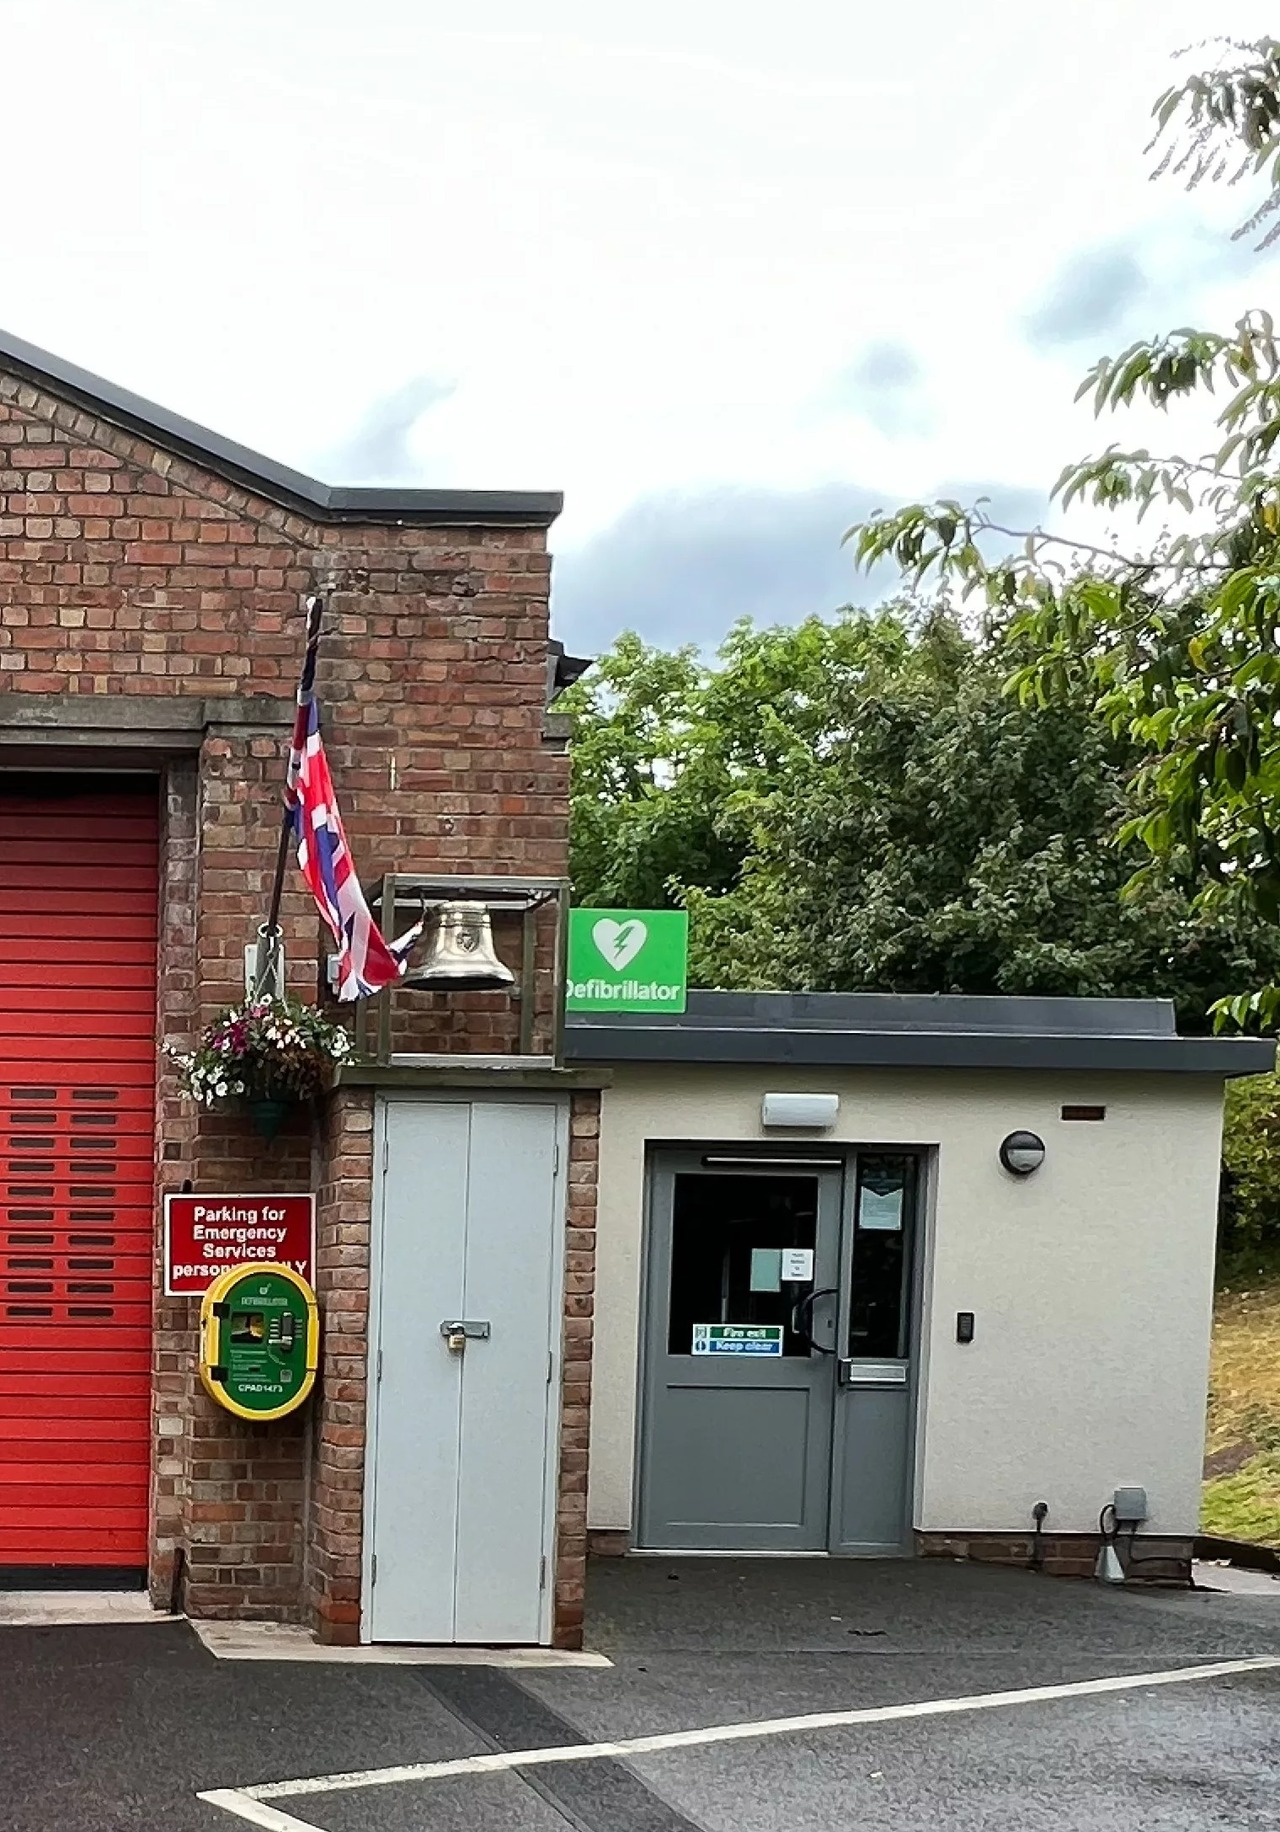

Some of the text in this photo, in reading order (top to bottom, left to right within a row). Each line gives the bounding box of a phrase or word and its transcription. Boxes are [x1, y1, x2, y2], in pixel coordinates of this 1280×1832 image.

[194, 1206, 286, 1224] Parking for
[193, 1225, 287, 1243] Emergency
[202, 1243, 277, 1259] Services
[723, 1328, 766, 1338] Fire exit
[715, 1341, 773, 1353] Keep clear
